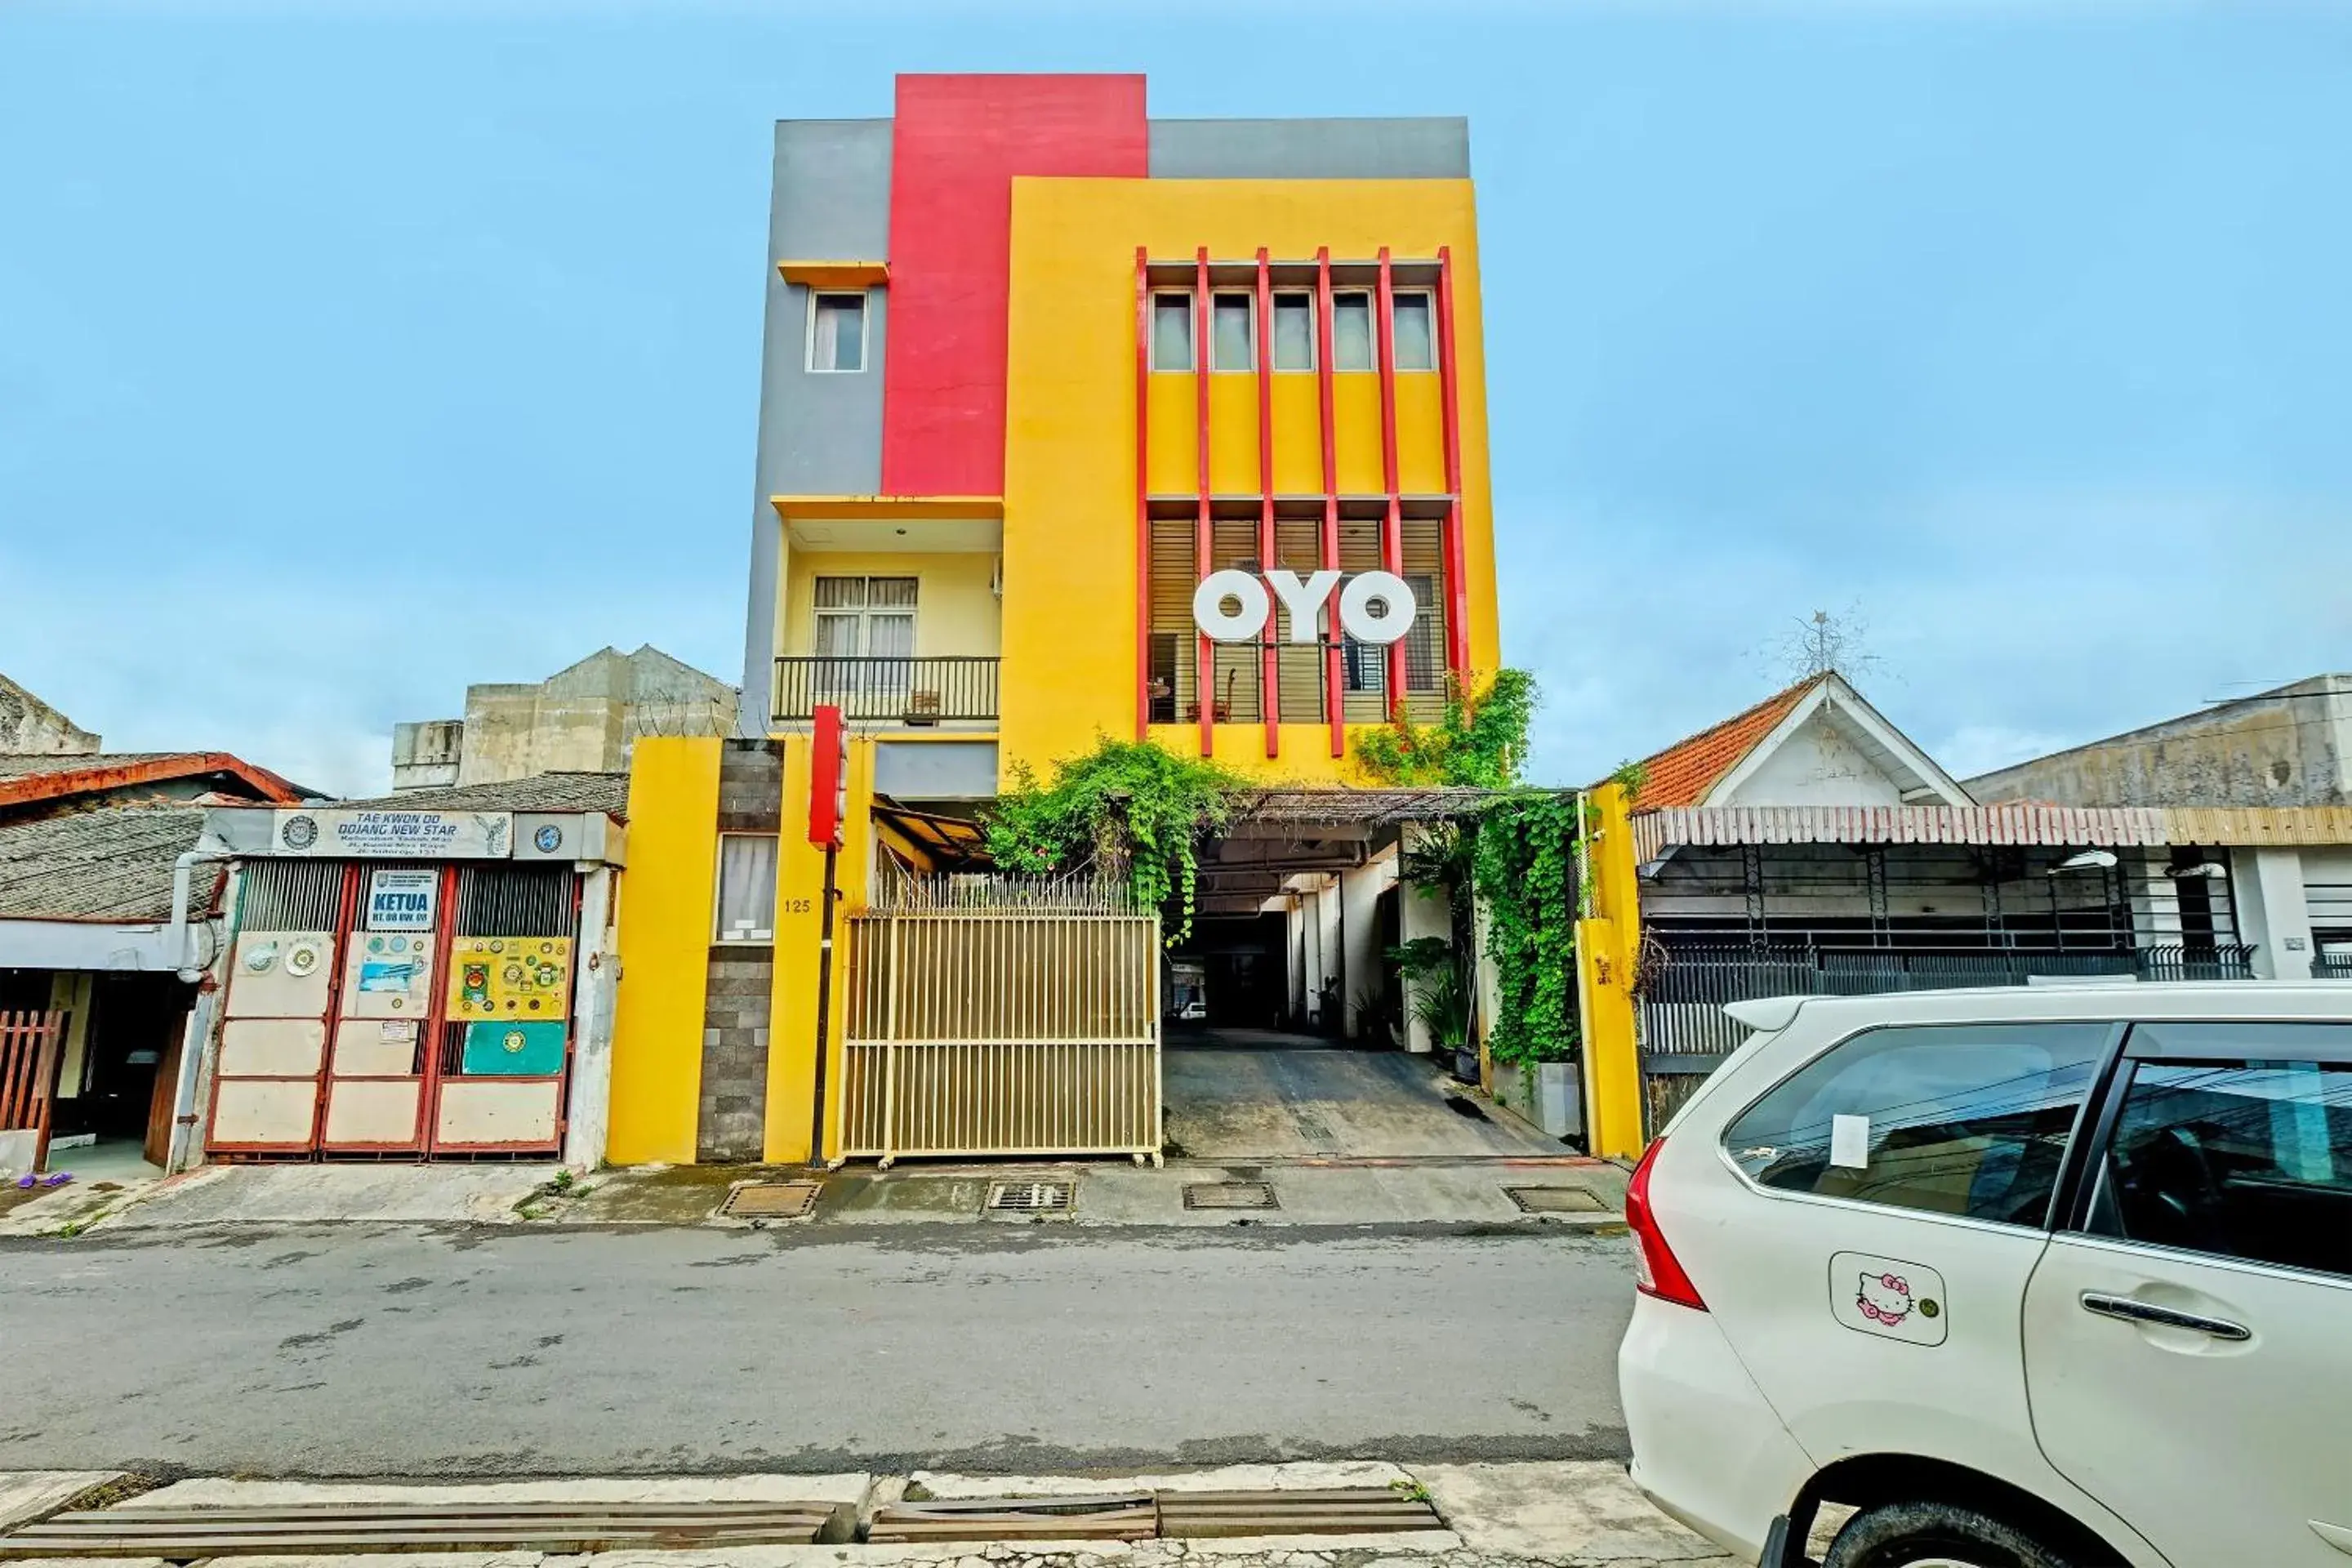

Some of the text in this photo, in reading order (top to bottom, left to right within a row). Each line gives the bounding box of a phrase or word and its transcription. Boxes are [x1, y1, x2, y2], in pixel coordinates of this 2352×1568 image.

[1193, 569, 1417, 644] OYO
[357, 813, 441, 824] TAE KWON DO
[337, 824, 457, 835] DOJANG NEW STAR
[374, 893, 427, 911] KETUA
[785, 900, 810, 913] 125
